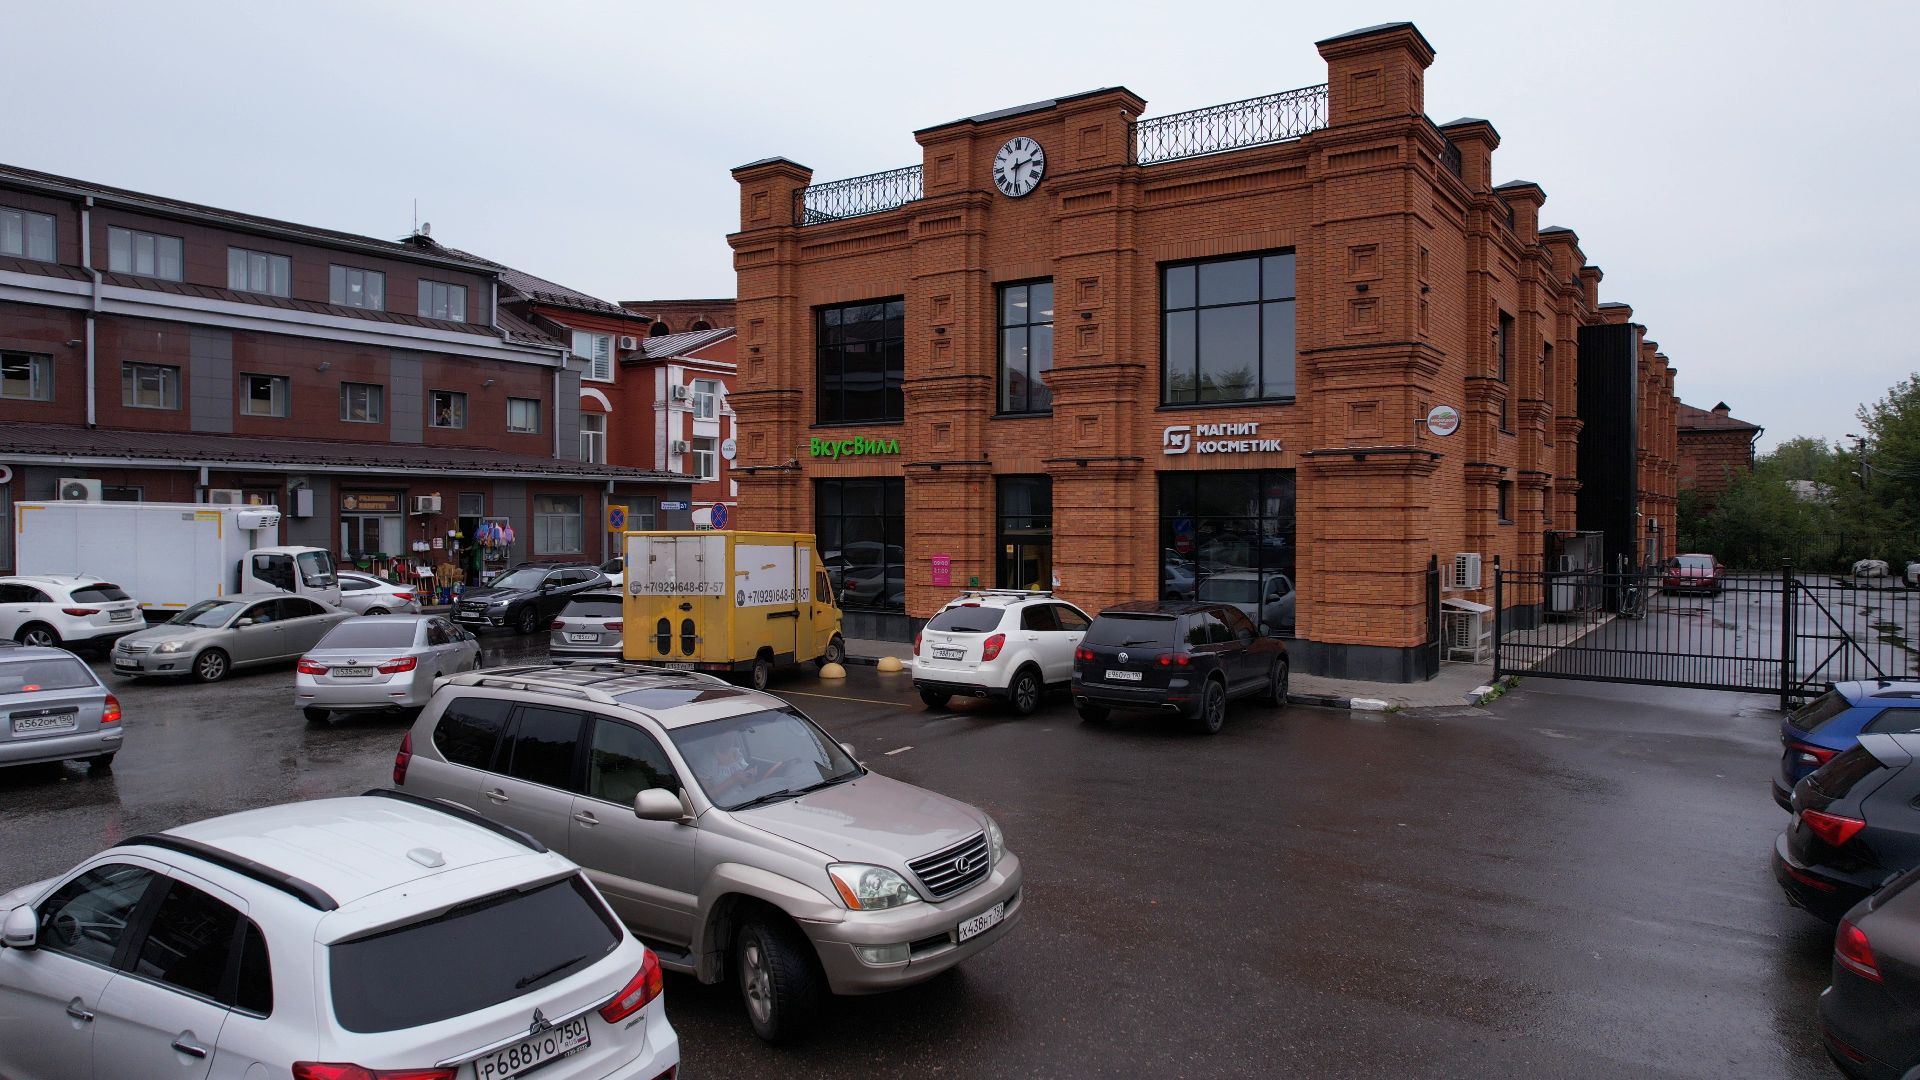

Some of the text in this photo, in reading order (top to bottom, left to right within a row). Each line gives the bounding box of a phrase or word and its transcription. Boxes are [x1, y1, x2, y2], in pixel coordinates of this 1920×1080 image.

[1196, 422, 1259, 437] МАГНИТ
[810, 436, 900, 461] ВкусВилл
[1196, 440, 1282, 454] КОСМЕТИК
[644, 582, 724, 594] +7(929)648-67-57
[18, 718, 57, 729] А562ОМ
[485, 1020, 582, 1080] Р688УО 750
